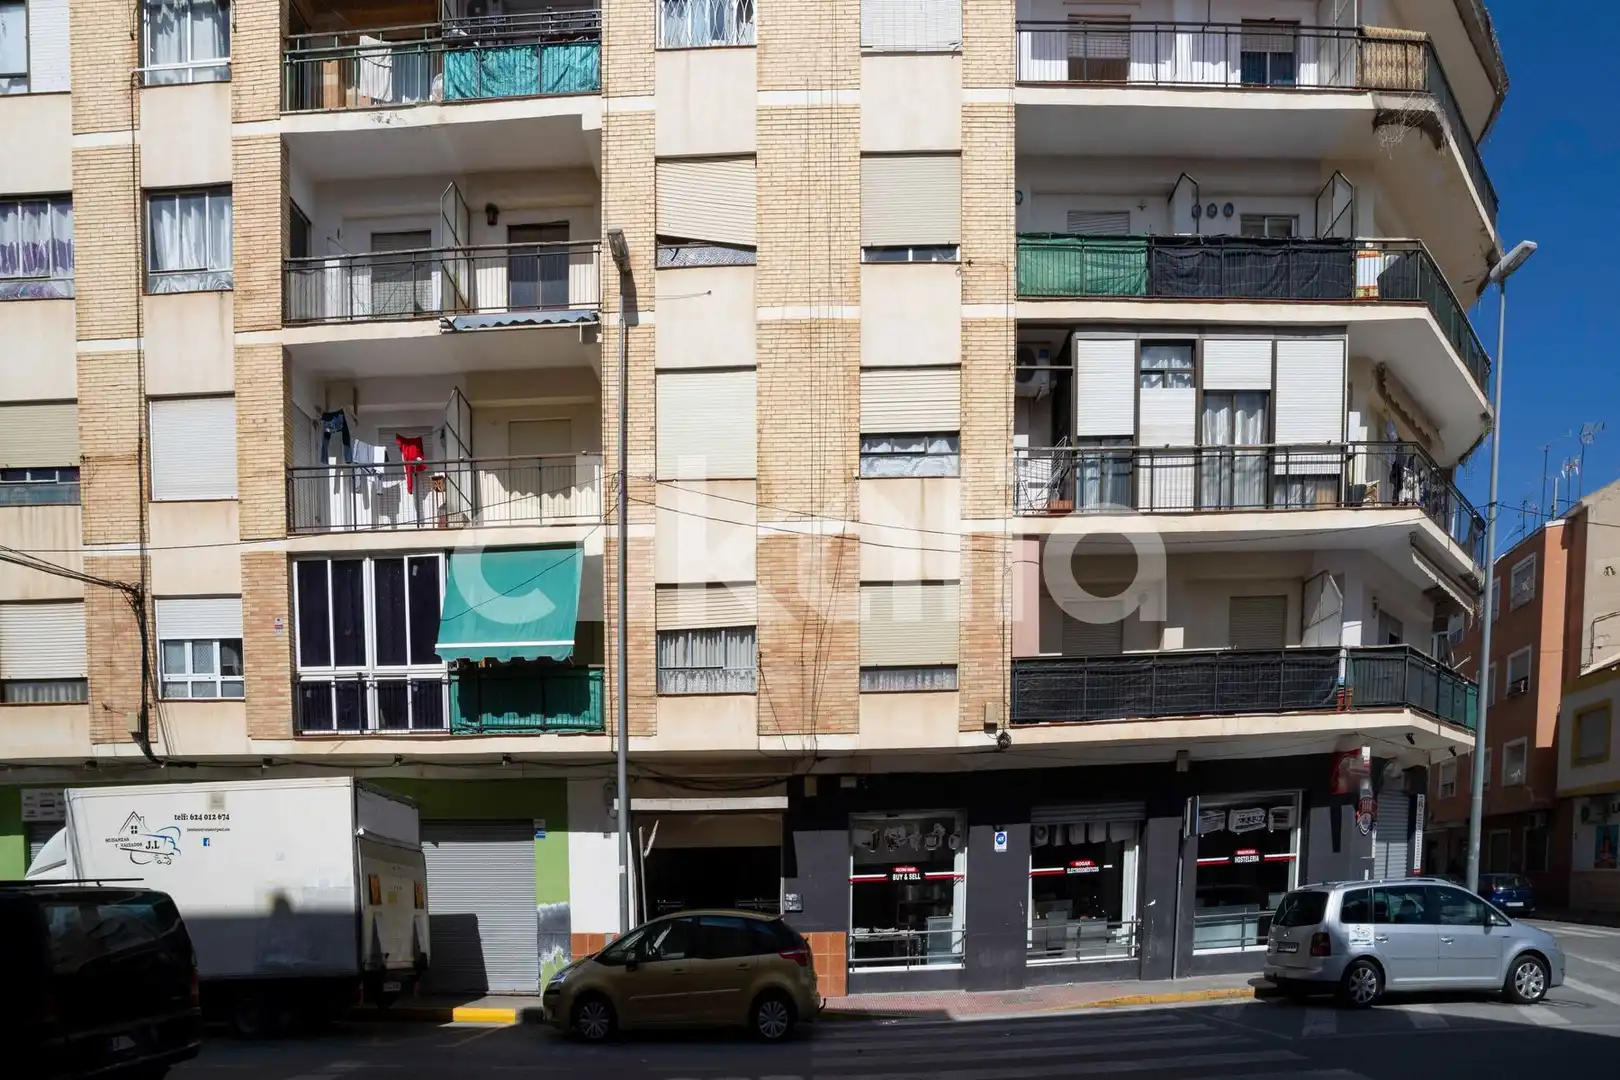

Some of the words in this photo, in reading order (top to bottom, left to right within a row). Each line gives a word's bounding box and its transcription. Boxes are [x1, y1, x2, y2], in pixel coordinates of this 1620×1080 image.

[190, 813, 202, 822] 624
[204, 813, 216, 821] 012
[218, 813, 230, 821] 674
[892, 873, 903, 881] BUY
